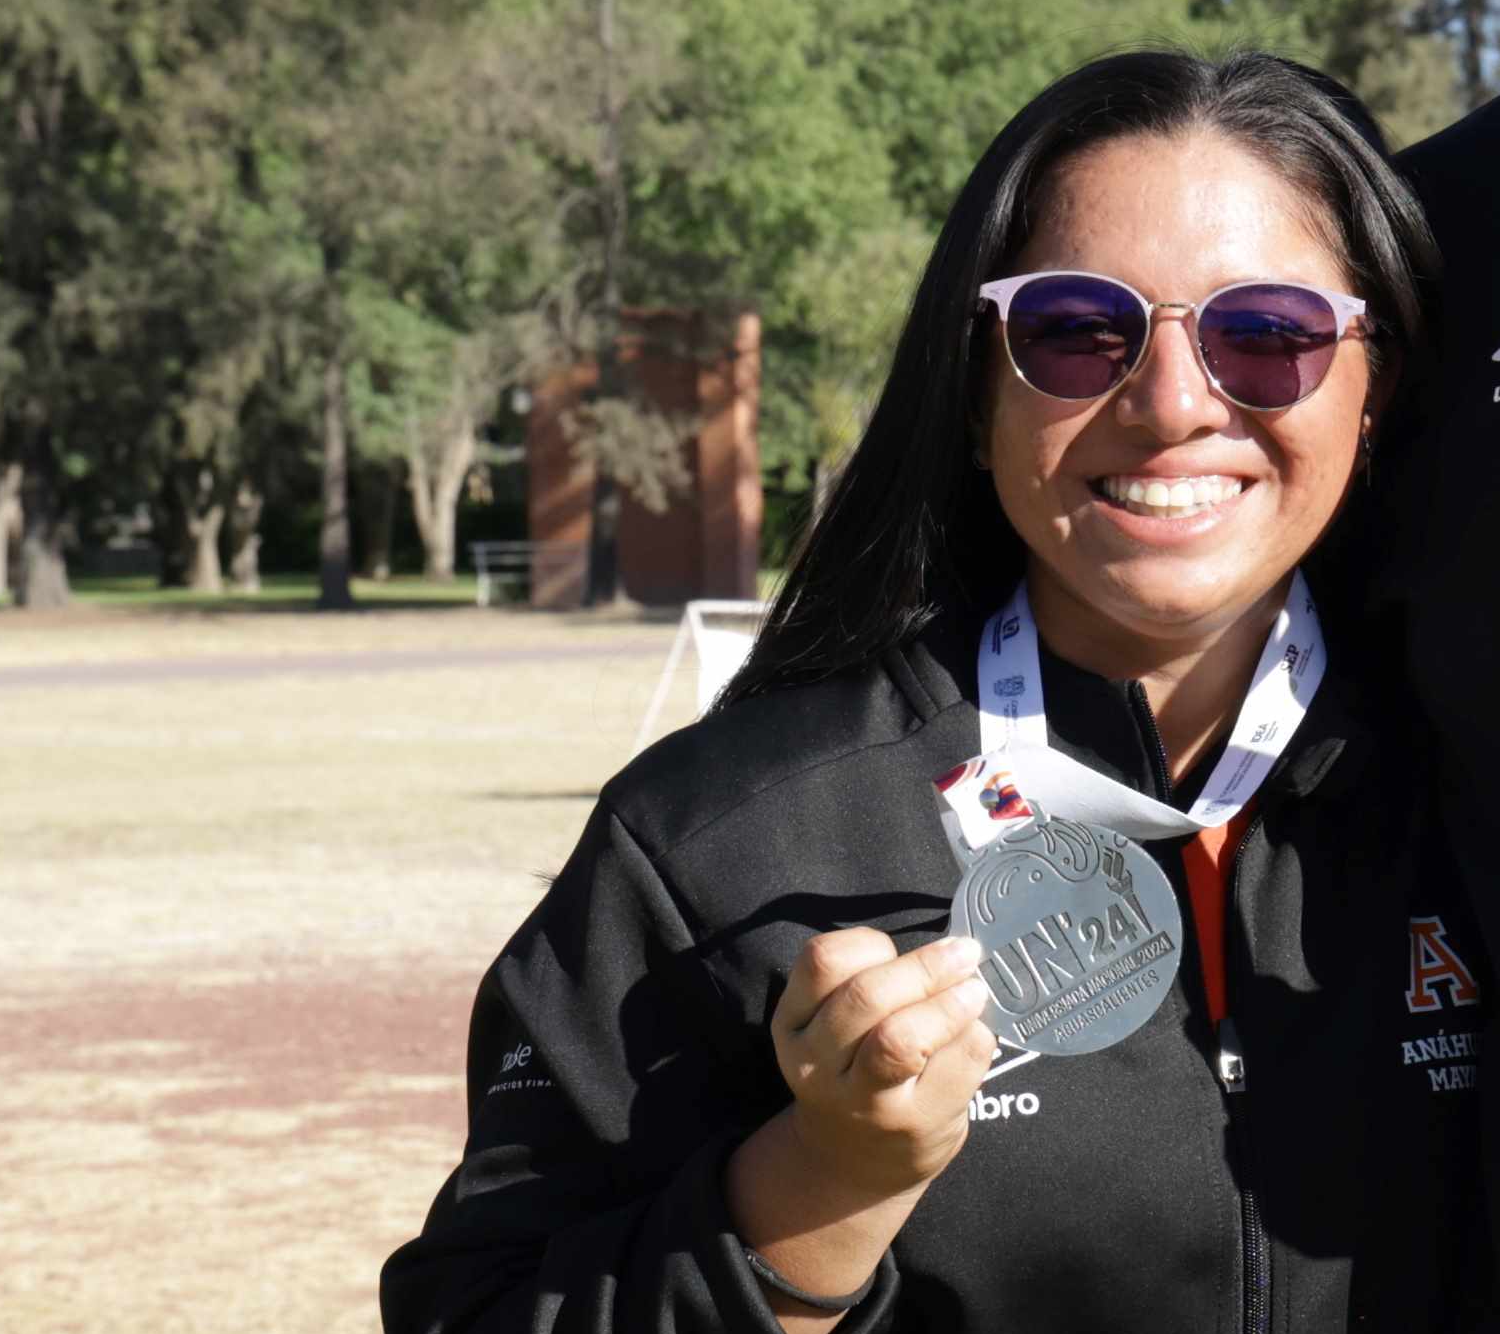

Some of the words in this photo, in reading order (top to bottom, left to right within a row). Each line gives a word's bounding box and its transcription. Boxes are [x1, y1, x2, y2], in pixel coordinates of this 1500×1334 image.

[1281, 643, 1300, 674] SEP
[1085, 954, 1137, 996] NACIONAL
[1137, 935, 1170, 965] 2024
[1052, 968, 1161, 1044] AGUASCALIENTES
[1427, 1064, 1476, 1092] MAY
